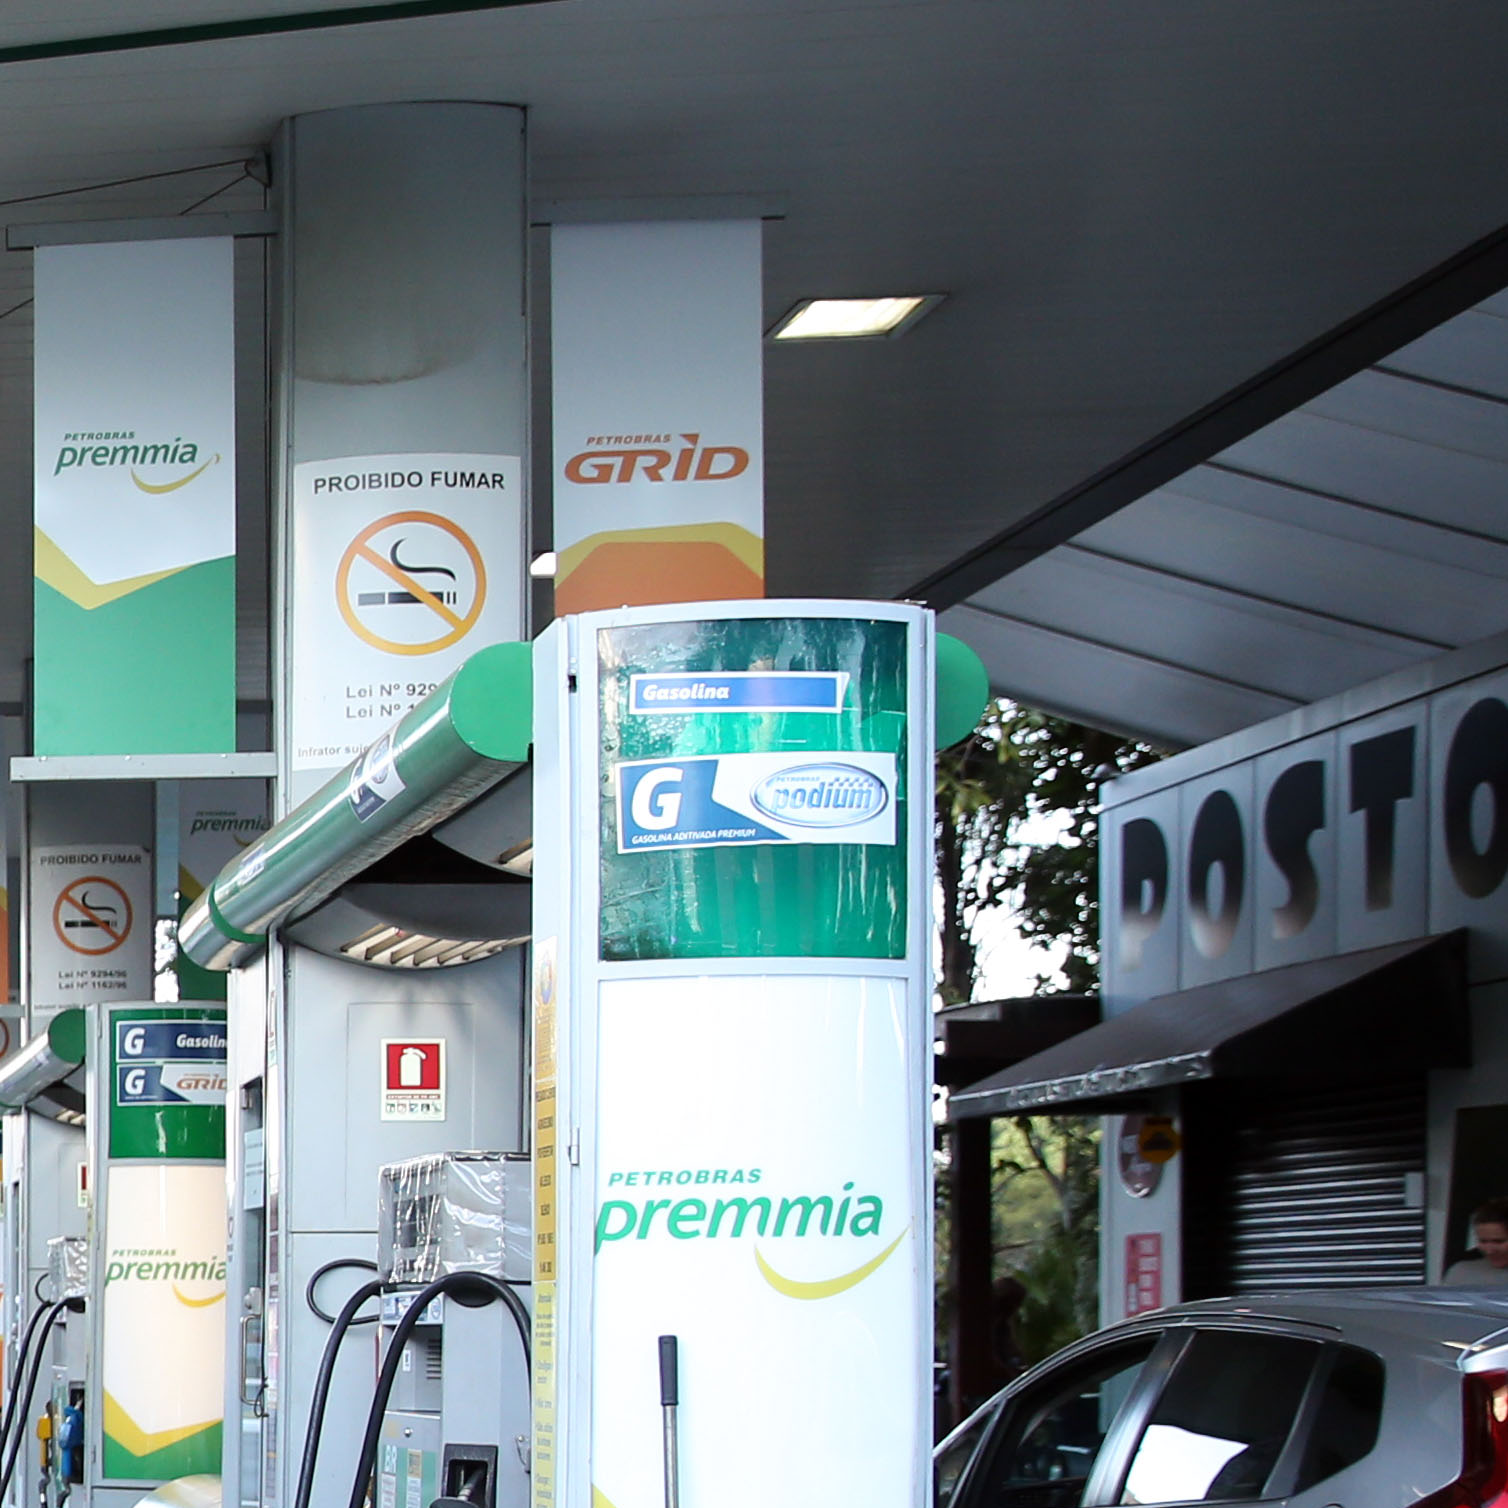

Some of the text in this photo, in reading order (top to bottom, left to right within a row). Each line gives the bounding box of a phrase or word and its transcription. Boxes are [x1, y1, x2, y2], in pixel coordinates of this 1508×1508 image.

[64, 431, 135, 441] PETROBRAS
[586, 434, 672, 446] PETROBRAS
[54, 436, 198, 476] premmia
[564, 433, 749, 485] GRID
[314, 471, 505, 495] PROIBIDO FUMAR
[346, 684, 373, 699] Lei
[642, 683, 729, 701] Gasolina
[346, 704, 373, 719] Lei
[298, 745, 340, 758] Infrator
[631, 767, 874, 831] G podium
[632, 828, 756, 845] GASOLINA ADITIVADA PREMIUM
[1120, 697, 1508, 972] POSTO
[40, 853, 142, 865] PROIBIDO FUMAR
[124, 1027, 227, 1056] G Gasolin
[125, 1068, 146, 1095] G
[608, 1168, 762, 1187] PETROBRAS
[594, 1181, 884, 1257] premmia
[112, 1249, 177, 1257] PETROBRAS
[104, 1255, 226, 1290] premmia
